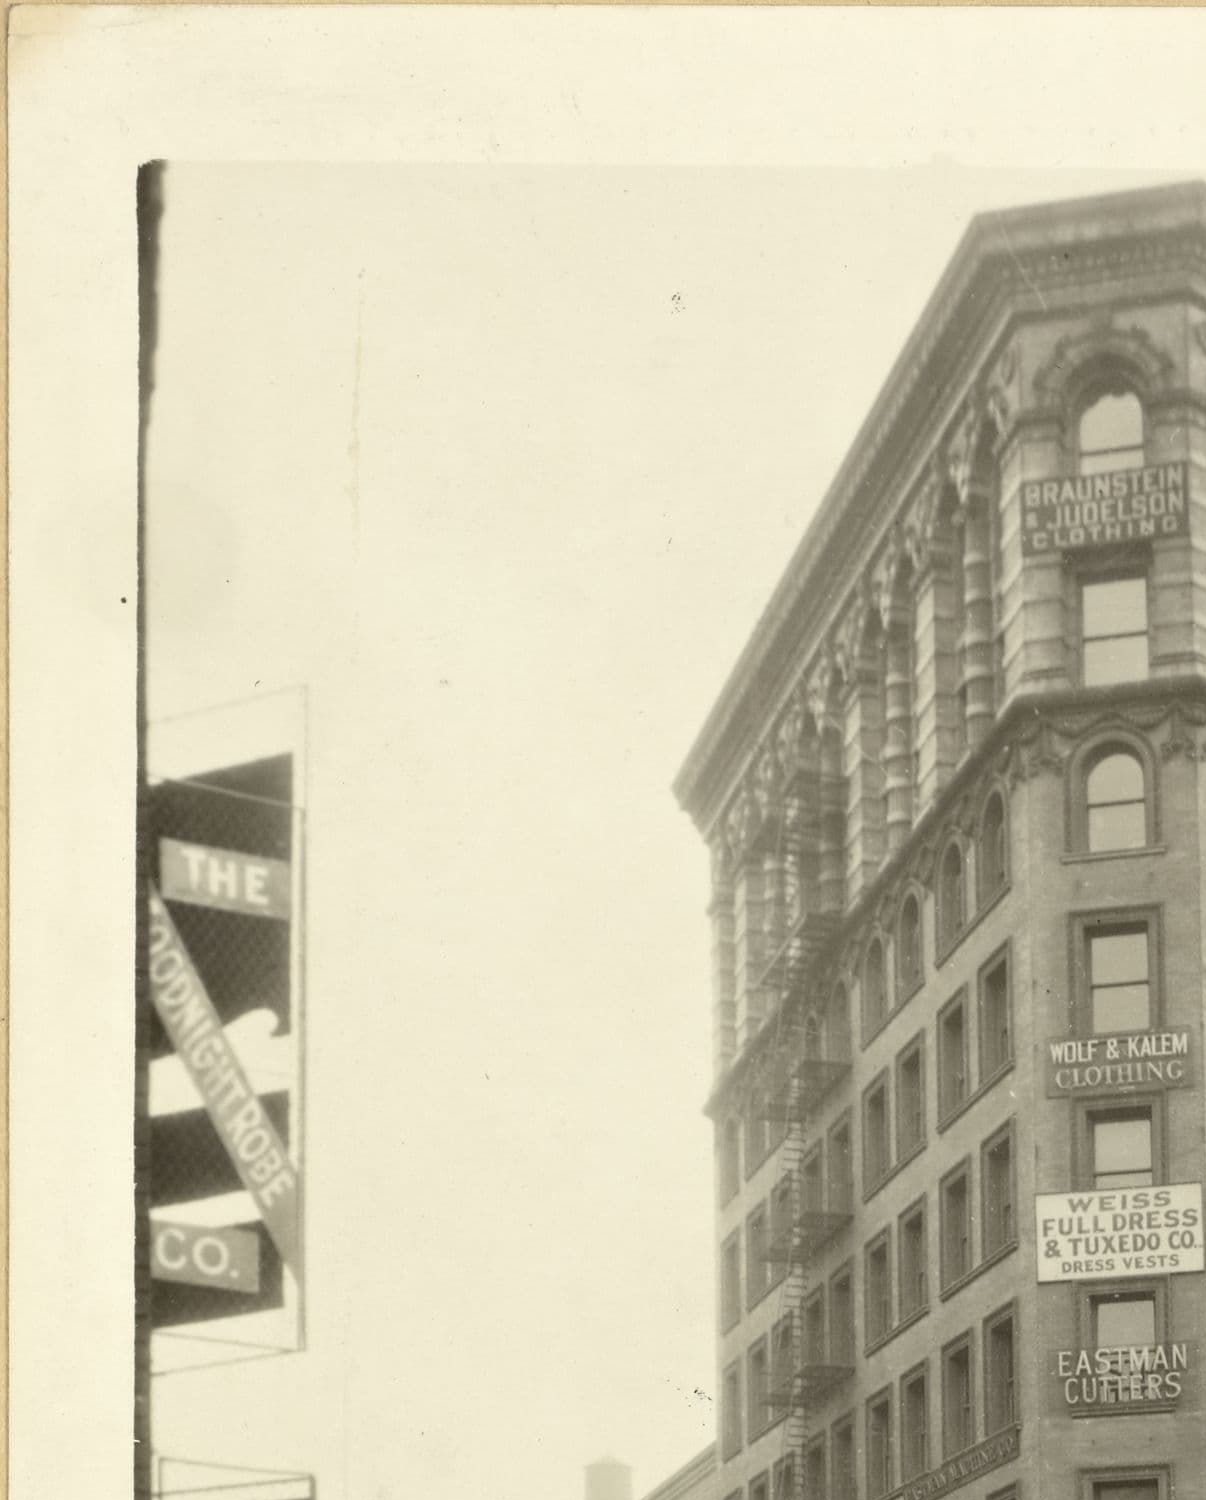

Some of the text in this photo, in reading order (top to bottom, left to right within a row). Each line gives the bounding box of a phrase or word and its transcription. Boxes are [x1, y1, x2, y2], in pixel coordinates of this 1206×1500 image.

[1024, 464, 1183, 508] BRAUNSTEIN
[1047, 488, 1184, 530] JUDELSON
[1031, 514, 1178, 549] CLOTHING
[179, 848, 270, 907] THE
[1050, 1032, 1188, 1065] WOLF & KALEM
[1055, 1060, 1184, 1089] CLOTHING
[226, 1104, 296, 1208] ROBE
[1067, 1190, 1172, 1213] WEISS
[1042, 1208, 1199, 1238] FULL DRESS
[155, 1227, 242, 1279] CO.
[1044, 1238, 1062, 1259] &
[1068, 1230, 1160, 1257] TUXEDO
[1062, 1253, 1180, 1275] DRESS VESTS
[1058, 1342, 1188, 1378] EASTMAN
[1065, 1371, 1183, 1404] CUTTERS
